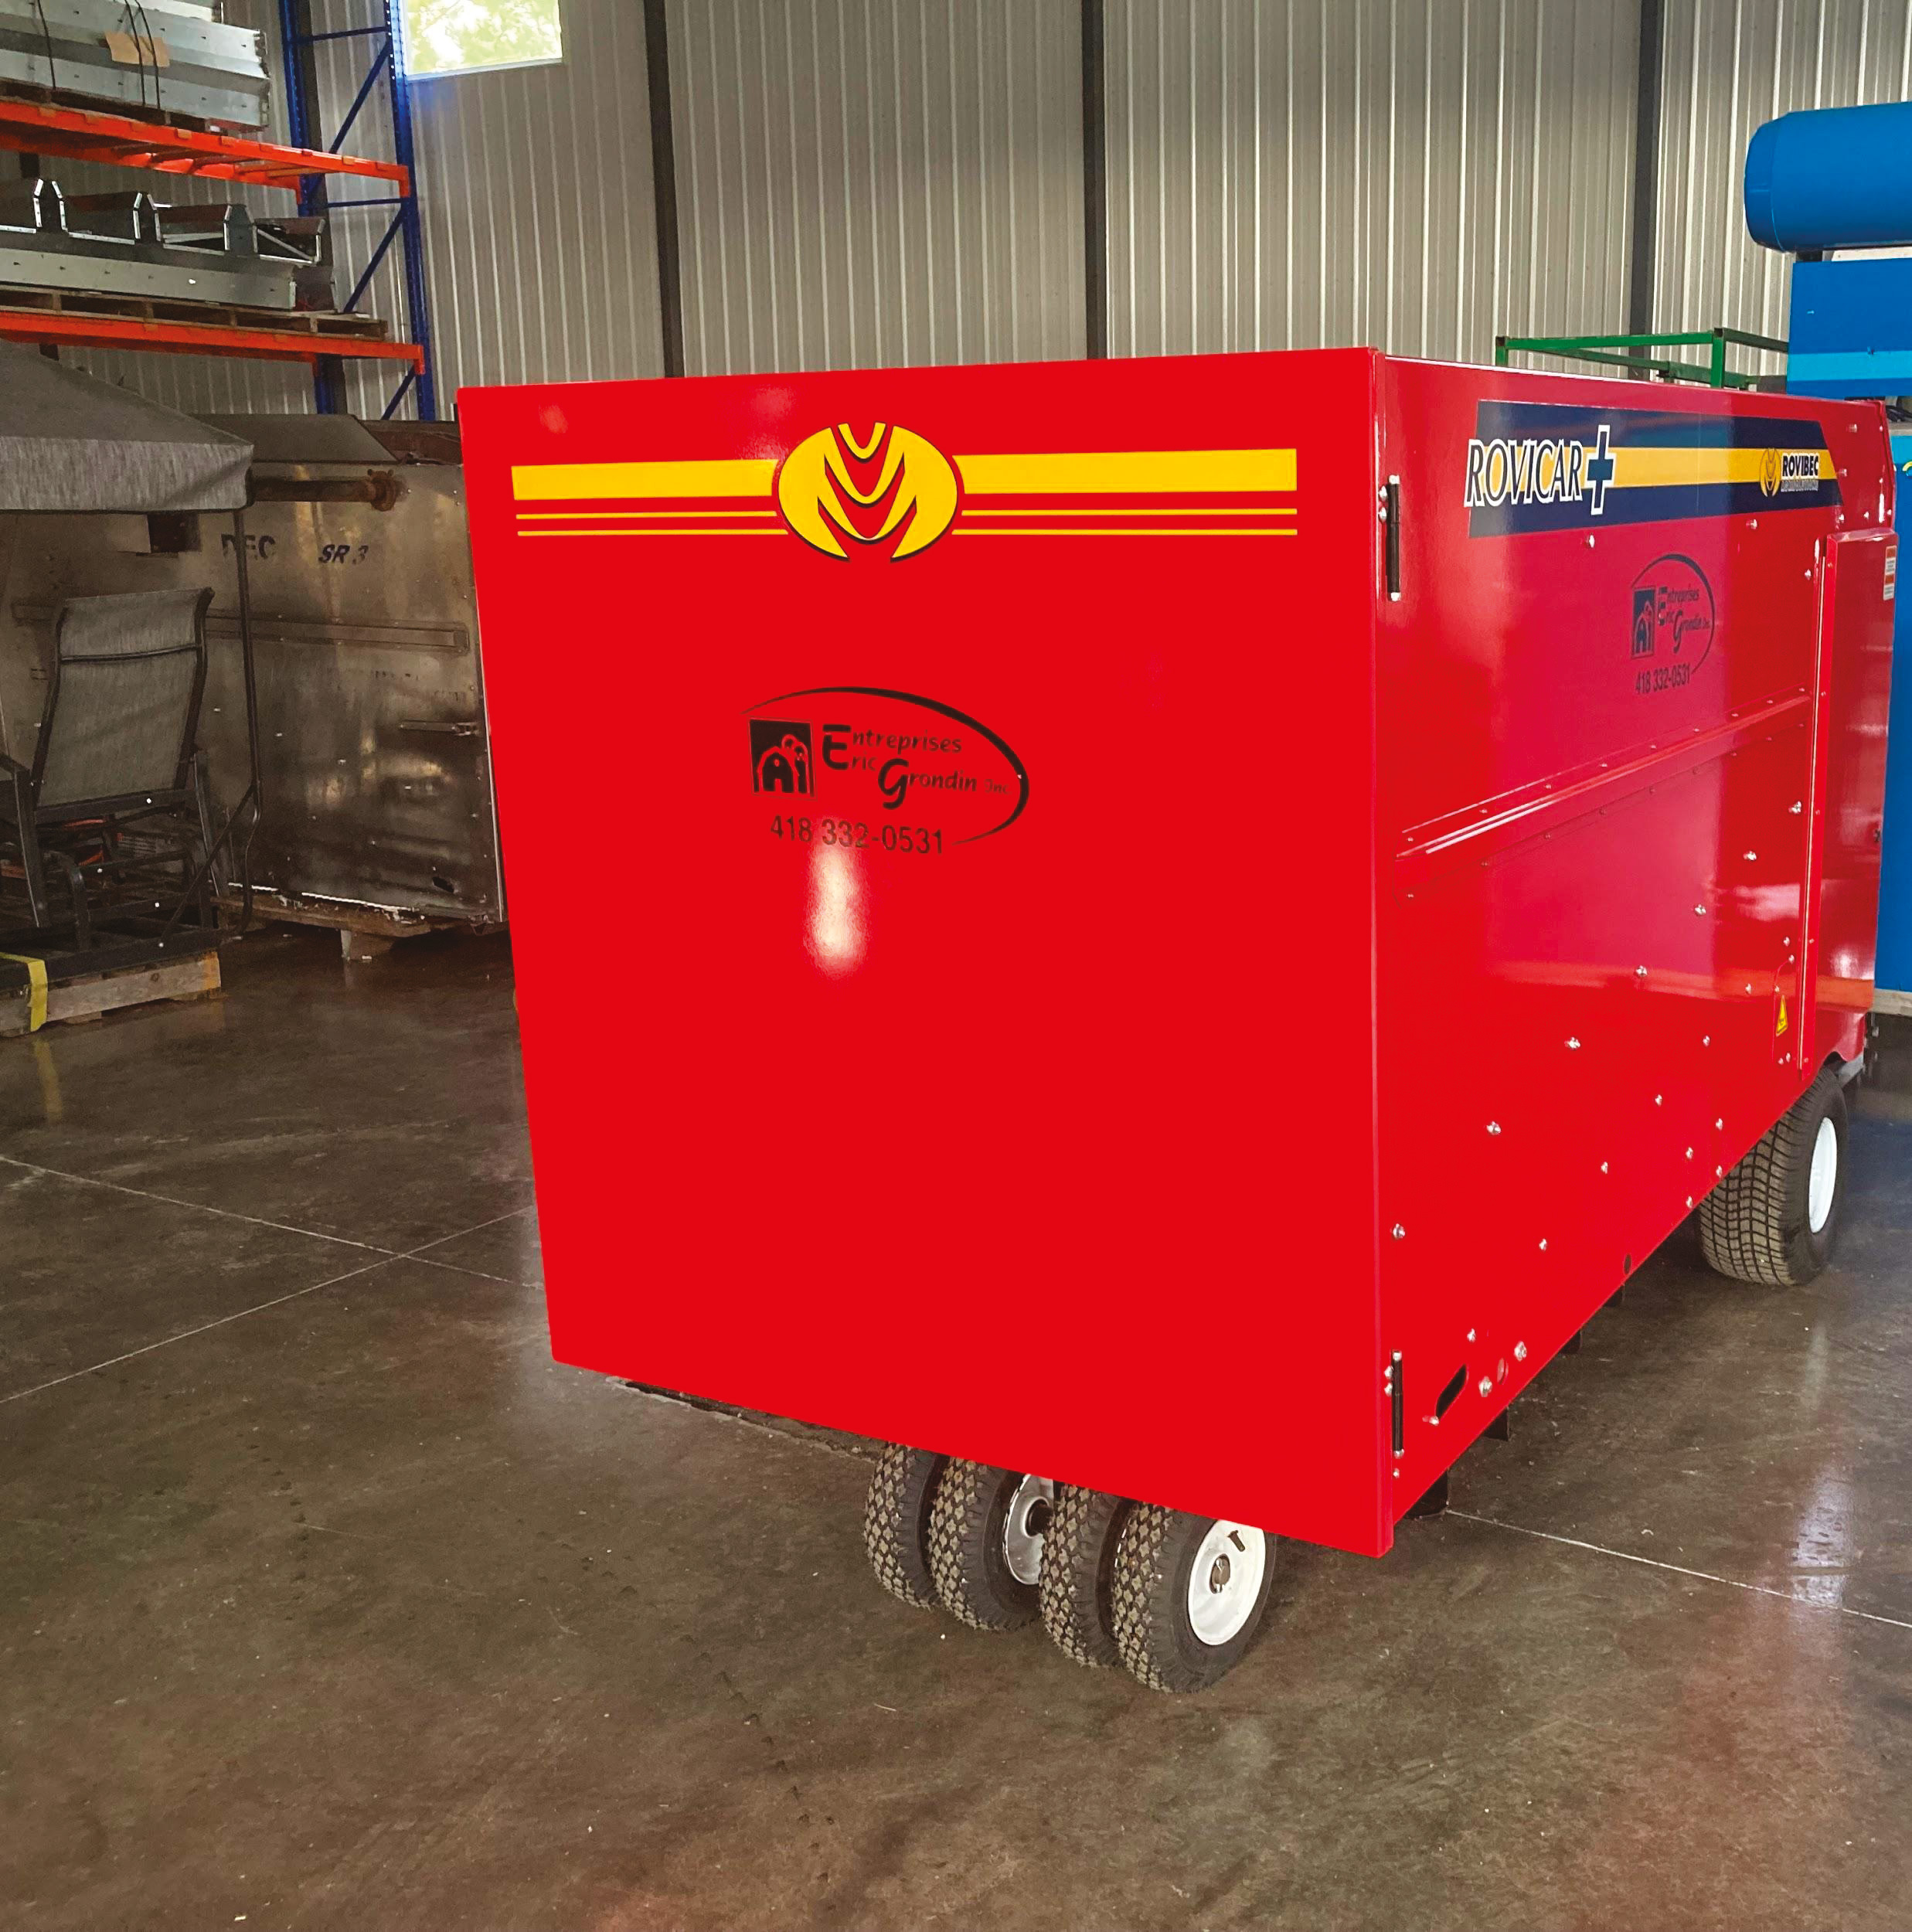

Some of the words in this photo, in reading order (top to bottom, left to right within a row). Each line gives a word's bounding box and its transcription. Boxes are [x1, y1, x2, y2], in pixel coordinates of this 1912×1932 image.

[1781, 452, 1820, 479] ROVIBEC
[318, 544, 350, 564] SR
[1635, 668, 1652, 695] 418
[1653, 663, 1691, 693] 332-0531
[822, 723, 962, 757] Entreprises
[878, 757, 977, 810] Grondin
[771, 815, 812, 842] 418
[821, 818, 943, 855] 332-0531
